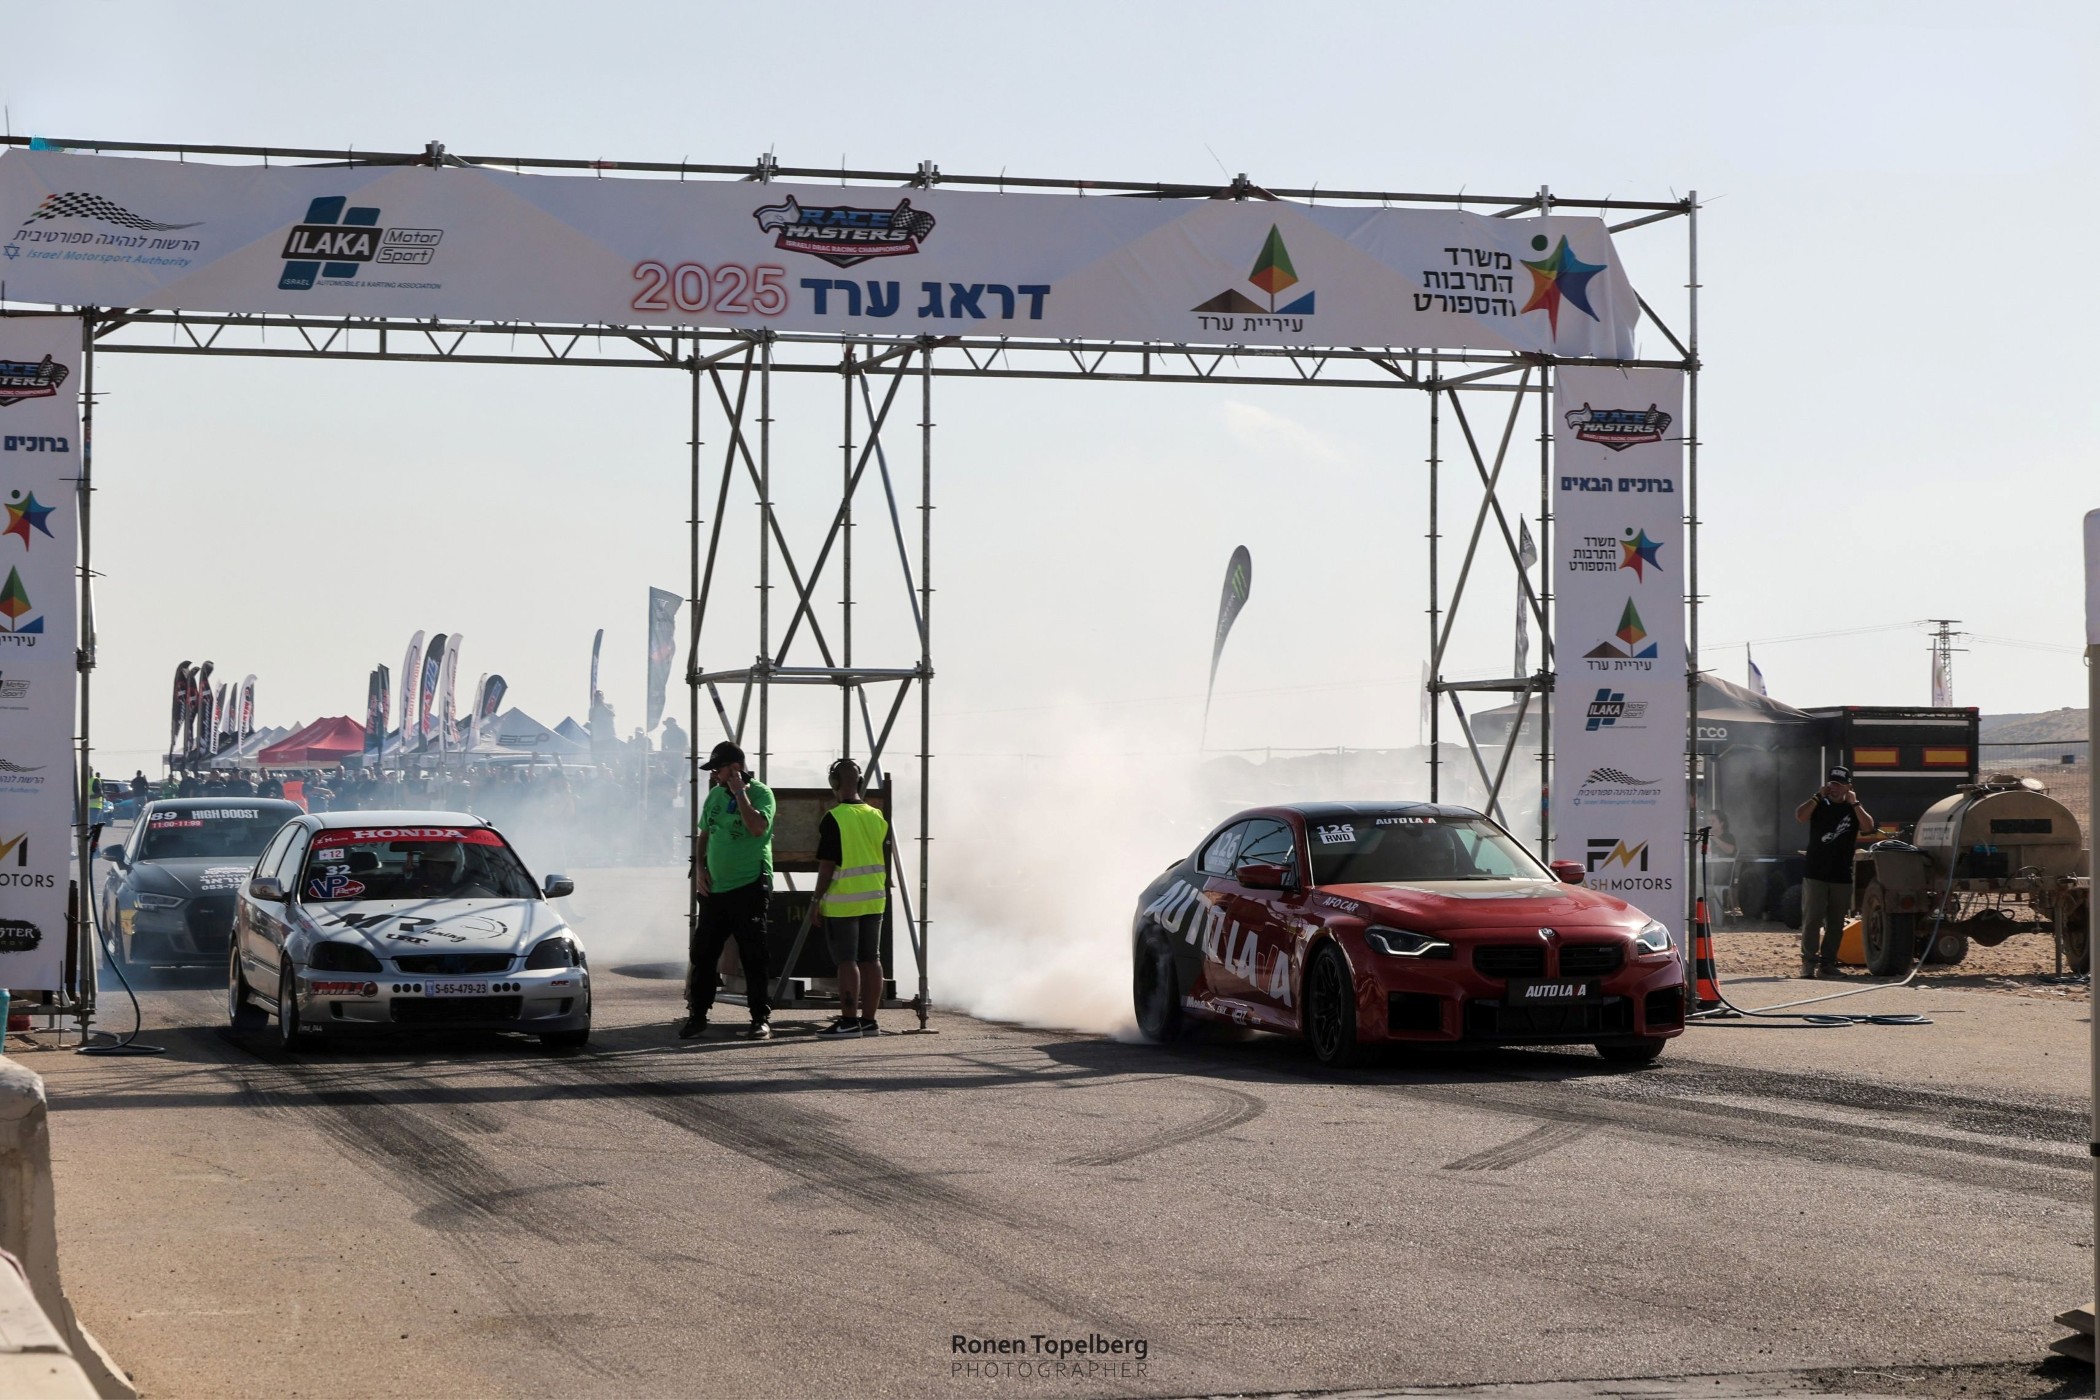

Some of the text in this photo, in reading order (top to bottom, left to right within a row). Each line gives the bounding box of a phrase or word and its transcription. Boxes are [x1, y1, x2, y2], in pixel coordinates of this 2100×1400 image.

[800, 209, 893, 227] RACE
[389, 231, 438, 243] Motor
[786, 225, 908, 241] MASTERS
[13, 229, 200, 251] הרשות לנהיגה ספורטיבית
[288, 231, 370, 256] ILAKA
[786, 240, 911, 254] ISRAELI DRAG RACING CHAMPIONSHIP
[27, 249, 192, 268] Israel Motorsport Authority
[381, 249, 428, 263] Sport
[1444, 247, 1513, 270] משרד
[282, 278, 310, 286] ISRAEL
[1424, 270, 1514, 294] התרבות
[633, 261, 787, 317] 2025
[800, 277, 1051, 320] דראג ערד
[1413, 293, 1517, 317] והספורט
[1198, 316, 1304, 333] עיריית ערד
[1592, 412, 1646, 423] RACE
[1583, 423, 1655, 433] MASTERS
[4, 435, 69, 452] ברוכים
[1561, 476, 1674, 493] ברוכים הבאים
[1584, 536, 1616, 547] משרד
[1573, 549, 1616, 560] התרבות
[1569, 560, 1617, 572] והספורט
[0, 636, 36, 647] עיריי
[1587, 660, 1652, 671] עיריית ערד
[1589, 704, 1620, 716] ILAKA
[150, 811, 178, 821] 89
[191, 809, 260, 819] HIGH BOOST
[1375, 817, 1408, 825] AUTO
[352, 828, 468, 839] HONDA
[1316, 823, 1354, 834] 126
[1325, 833, 1350, 843] RWD
[1212, 832, 1242, 859] 126
[326, 864, 352, 876] 32
[310, 875, 350, 899] VP
[1582, 878, 1673, 890] ASH MOTORS
[1340, 900, 1359, 912] CAR
[1144, 879, 1292, 1008] AUTO LAVA
[435, 983, 487, 994] S-65-479-23
[1525, 984, 1587, 997] AUTO LAA
